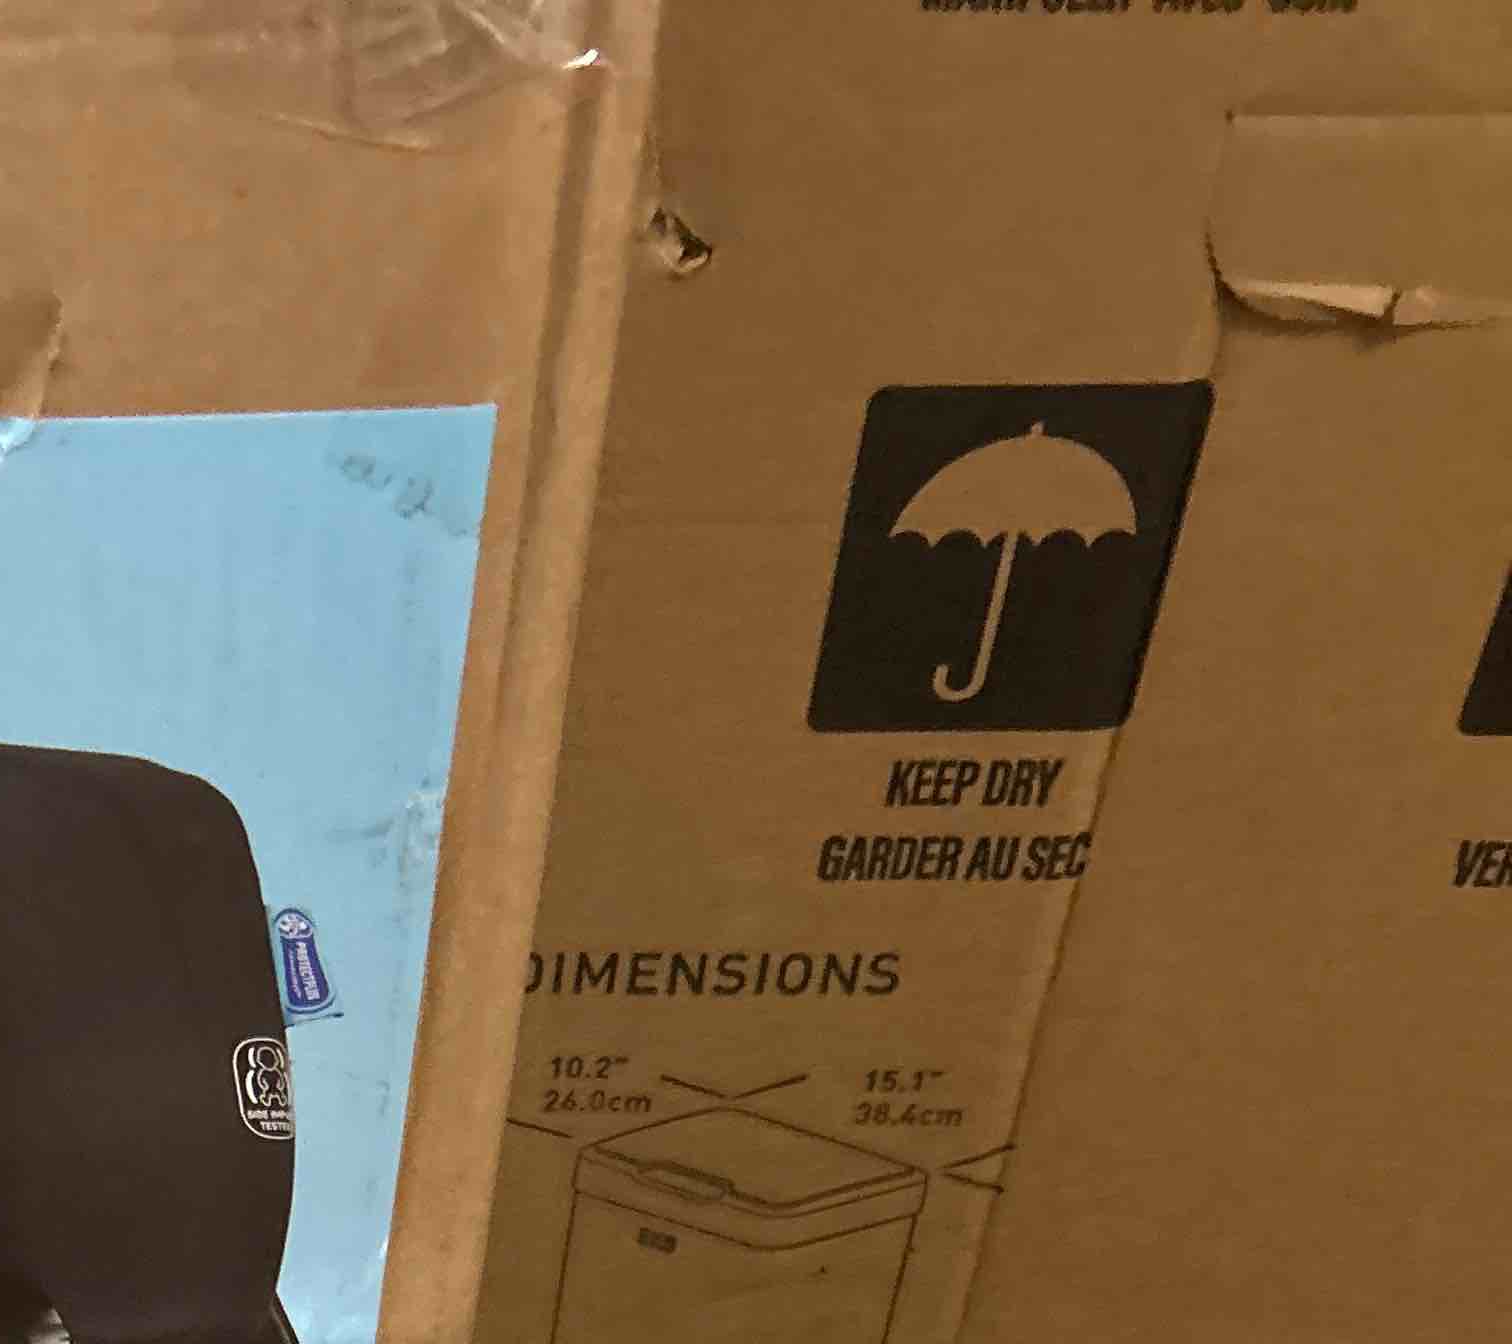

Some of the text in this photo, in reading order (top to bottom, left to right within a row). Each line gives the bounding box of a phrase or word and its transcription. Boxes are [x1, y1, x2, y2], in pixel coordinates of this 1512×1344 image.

[885, 758, 1065, 808] KEEP DRY
[817, 831, 1092, 883] GARDER AU SEC
